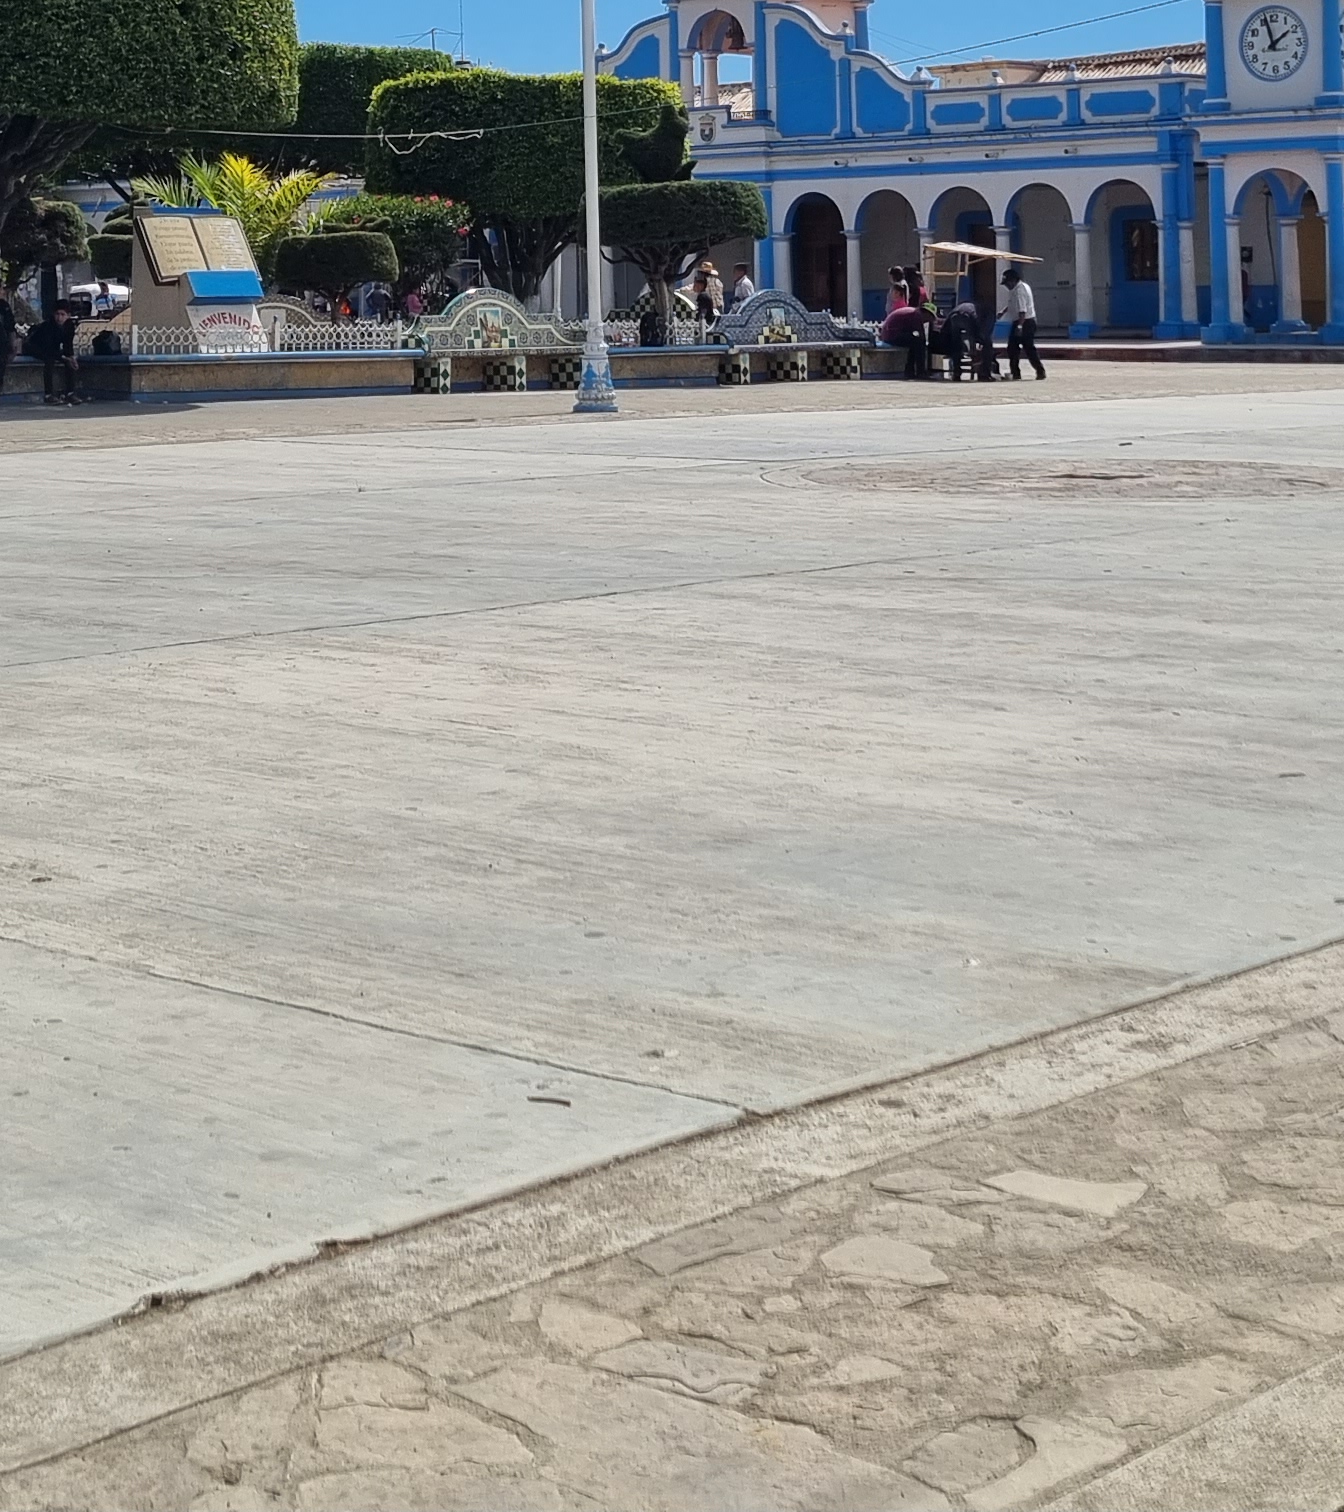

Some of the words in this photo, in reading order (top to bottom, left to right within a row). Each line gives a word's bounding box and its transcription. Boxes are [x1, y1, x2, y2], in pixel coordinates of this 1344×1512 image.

[1269, 13, 1279, 23] 12
[1283, 16, 1288, 25] 1
[1251, 28, 1259, 37] 10
[1291, 24, 1298, 33] 2
[1247, 41, 1255, 50] 9
[1295, 37, 1303, 47] 3
[1251, 54, 1259, 63] 8
[1291, 51, 1299, 60] 4
[1261, 62, 1269, 71] 7
[1272, 65, 1279, 74] 6
[1283, 61, 1290, 70] 5
